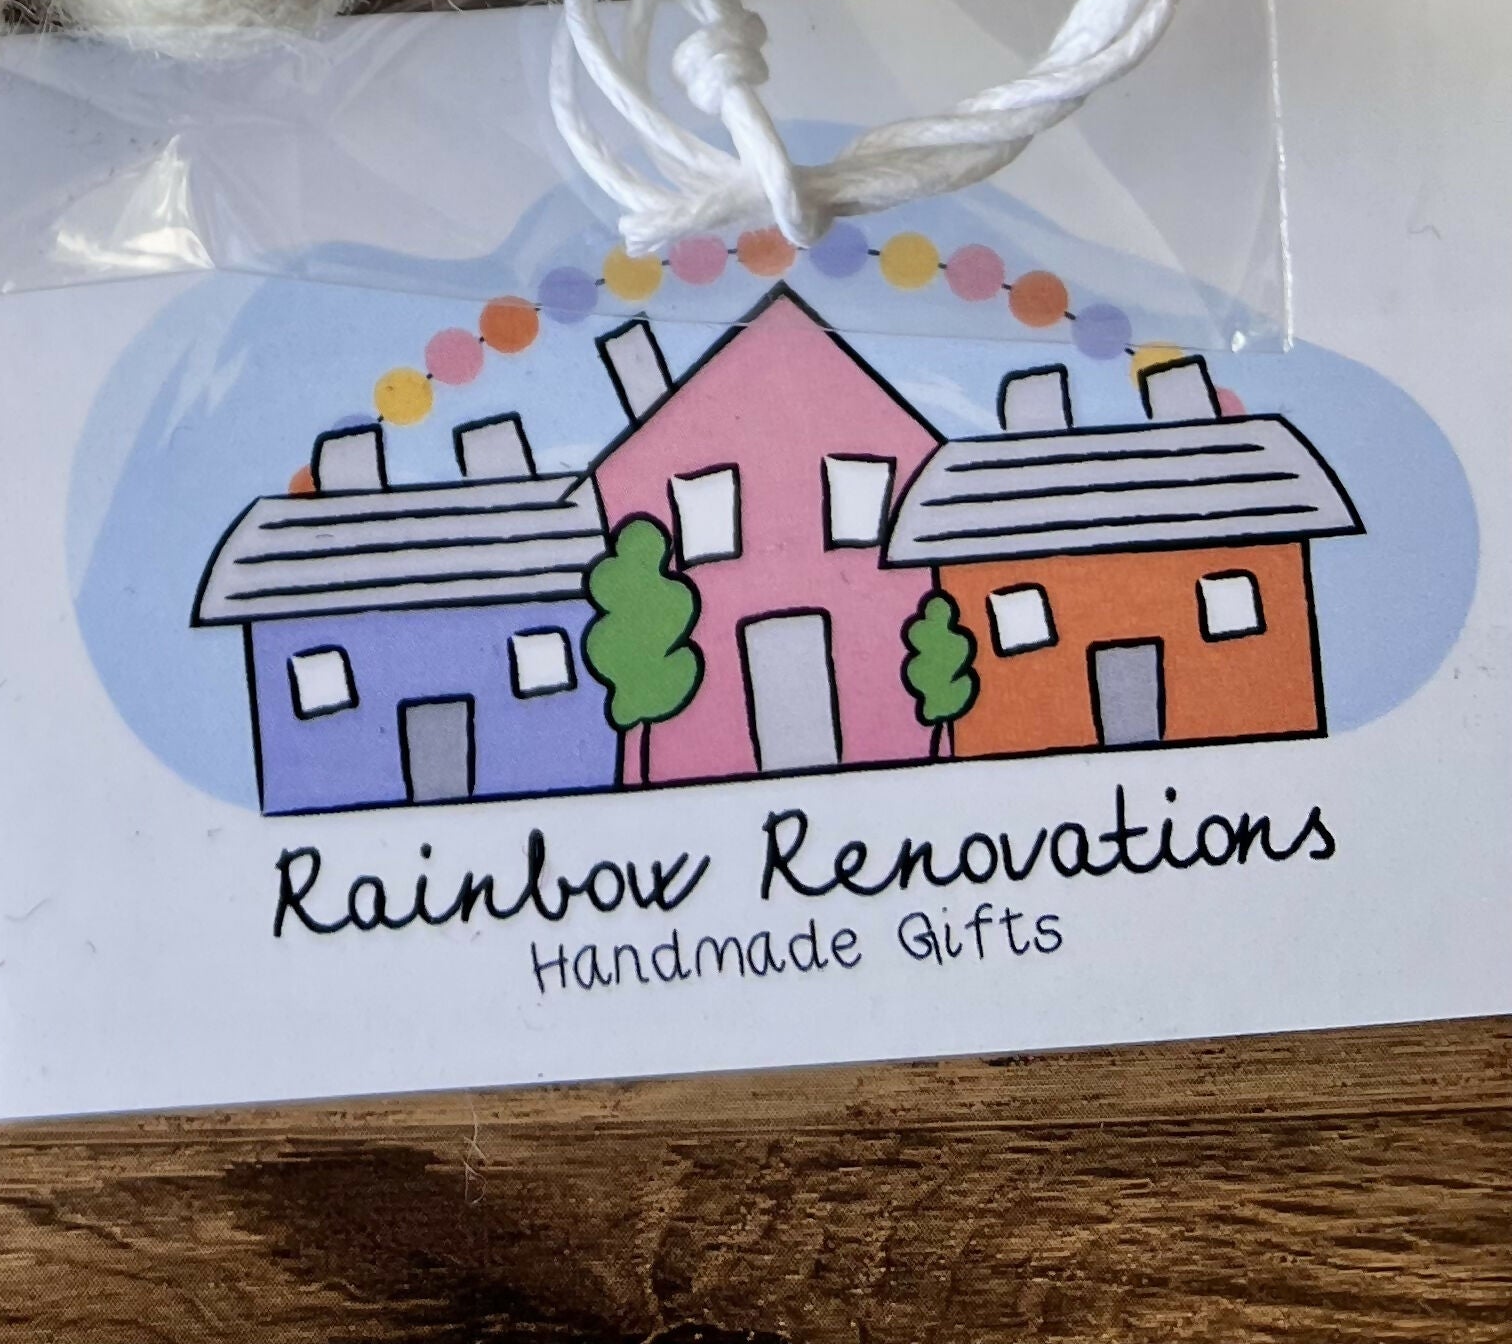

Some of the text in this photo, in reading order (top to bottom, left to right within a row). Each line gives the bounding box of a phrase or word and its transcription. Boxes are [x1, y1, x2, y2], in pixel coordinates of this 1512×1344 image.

[272, 783, 1338, 939] Rainbow Renovations
[530, 902, 1064, 995] Handmade Gifts
